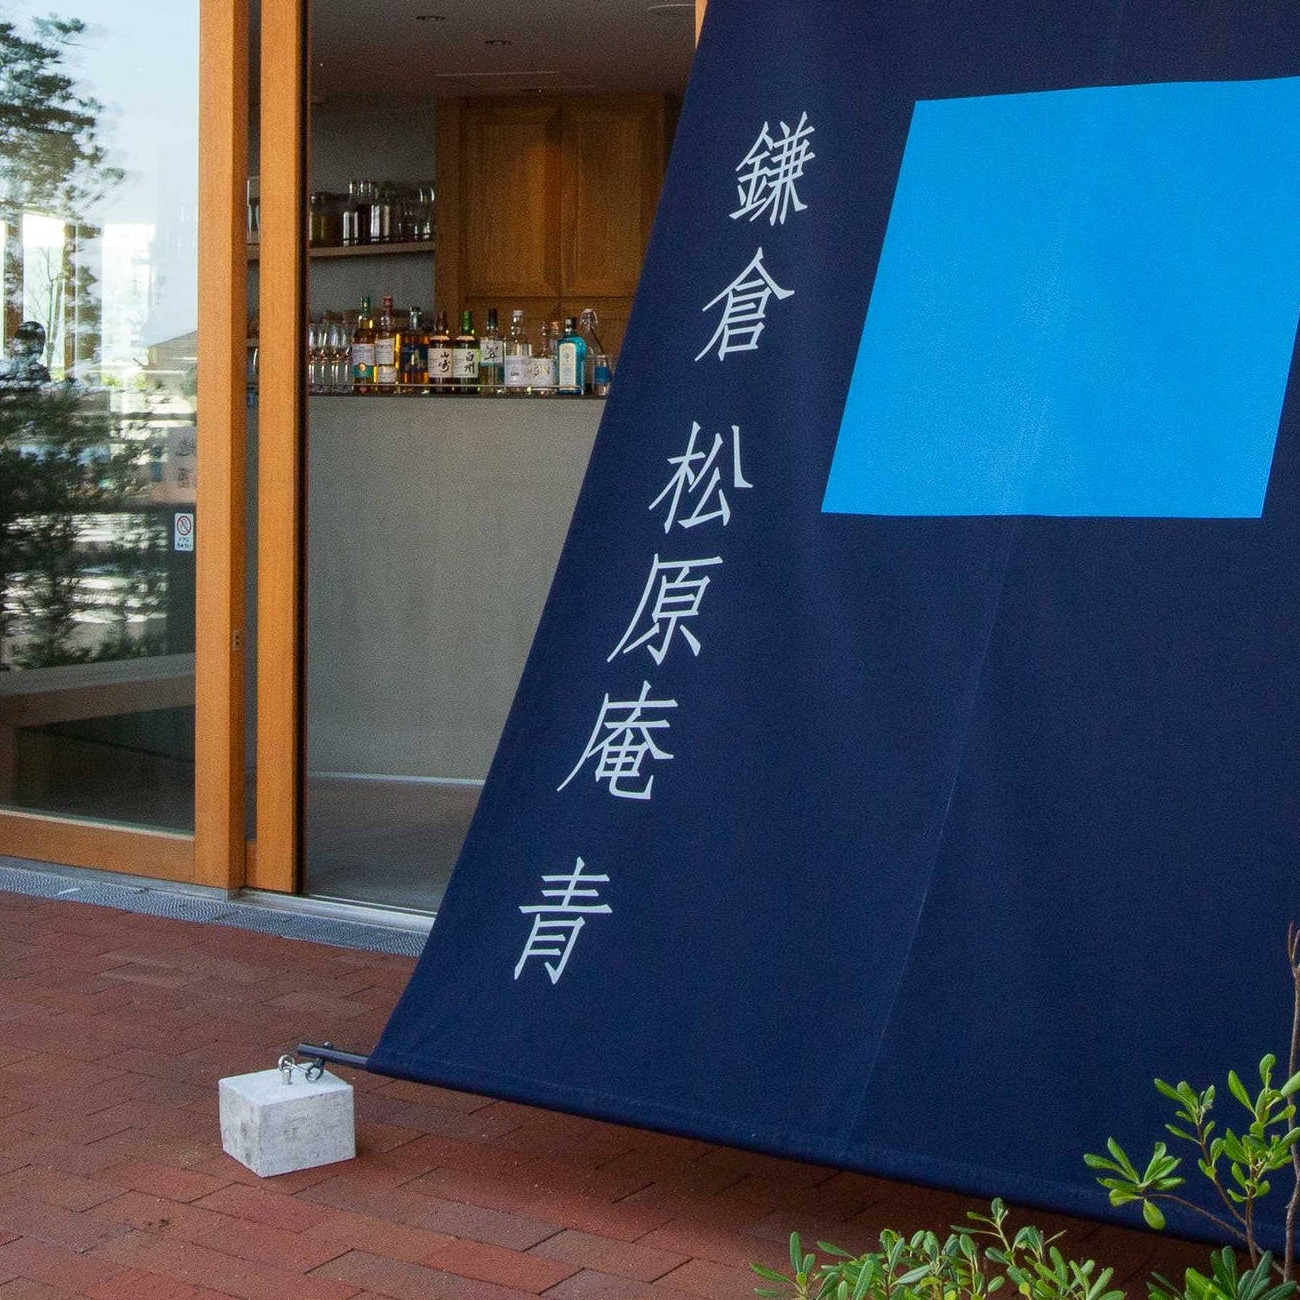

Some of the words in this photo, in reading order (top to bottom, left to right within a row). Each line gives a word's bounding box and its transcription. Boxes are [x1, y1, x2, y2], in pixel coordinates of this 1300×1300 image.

[694, 111, 816, 362] 鎌倉
[556, 421, 754, 800] 松原庵
[514, 856, 613, 985] 青
